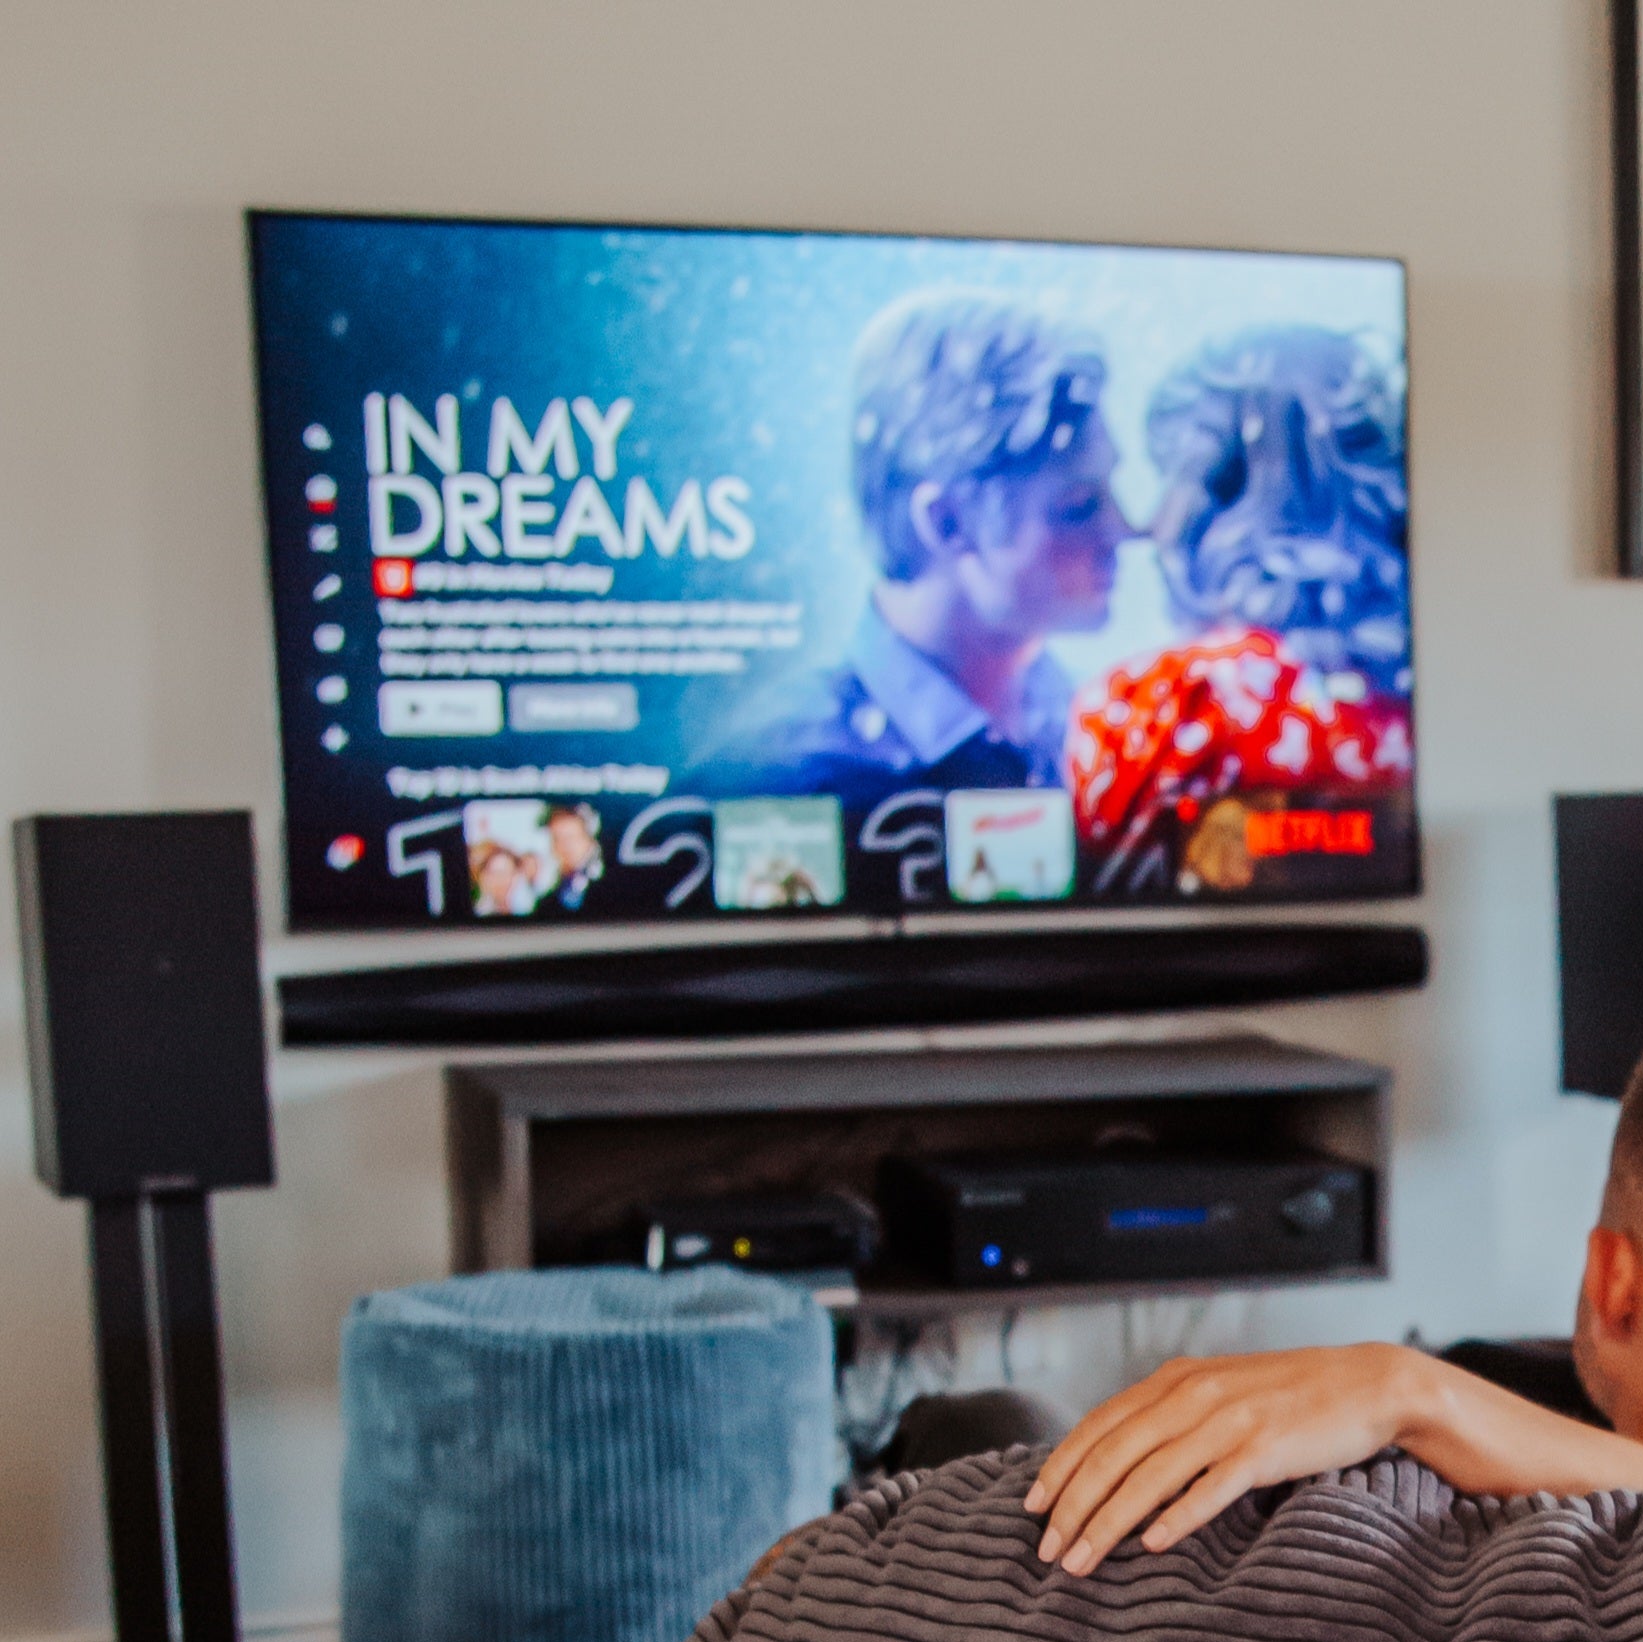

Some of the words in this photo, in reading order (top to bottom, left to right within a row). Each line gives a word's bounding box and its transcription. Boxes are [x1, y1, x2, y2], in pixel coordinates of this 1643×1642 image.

[364, 391, 462, 477] IN
[487, 396, 635, 482] MY
[367, 472, 756, 561] DREAMS
